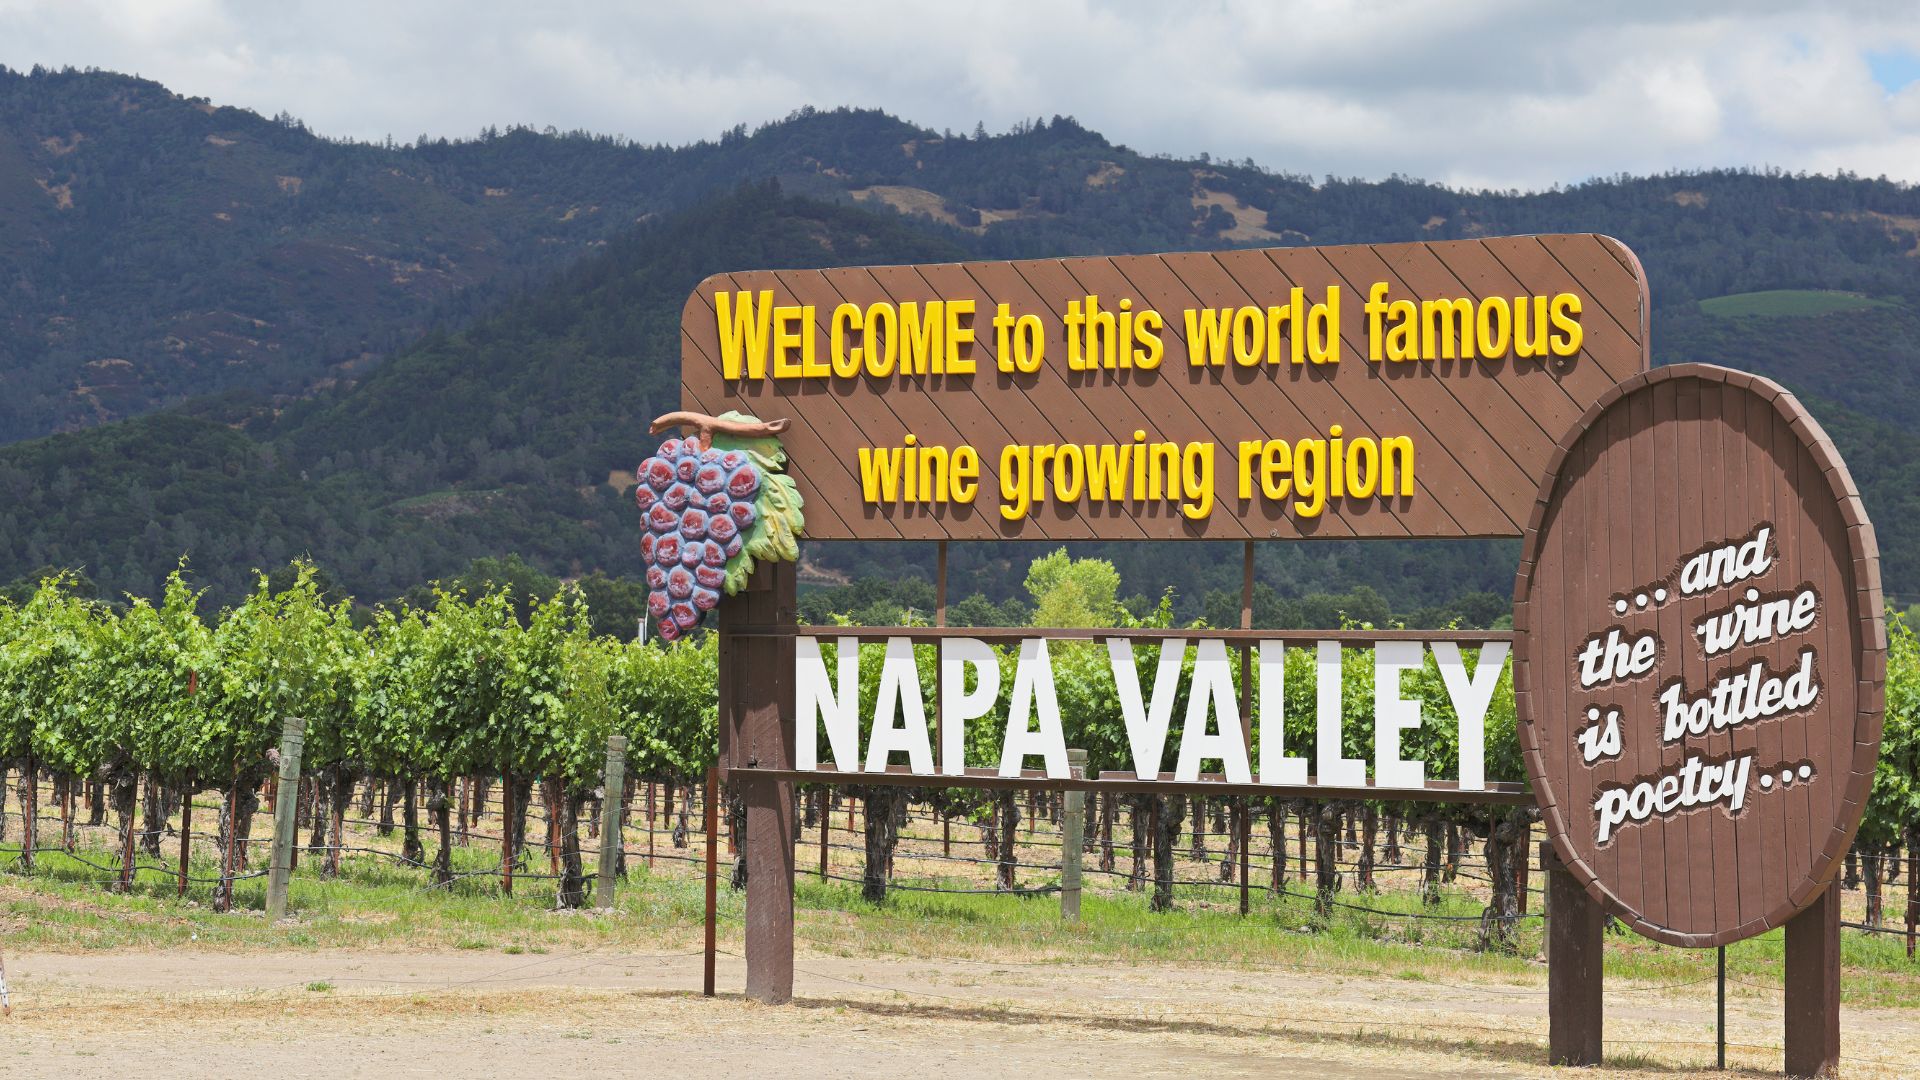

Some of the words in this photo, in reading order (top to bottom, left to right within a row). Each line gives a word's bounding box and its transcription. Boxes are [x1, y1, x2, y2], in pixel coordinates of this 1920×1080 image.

[714, 289, 977, 380] WELCOME
[992, 302, 1045, 374] to
[1064, 295, 1165, 372] this
[1183, 285, 1342, 368] world
[1364, 281, 1585, 363] famous
[858, 433, 981, 506] wine
[999, 429, 1215, 521] growing
[1237, 424, 1416, 519] region
[1578, 630, 1655, 687] the
[1697, 588, 1816, 654] wine
[795, 636, 1072, 780] NAPA
[1105, 638, 1511, 792] VALLEY
[1577, 708, 1621, 762] is
[1659, 652, 1818, 742] bottled
